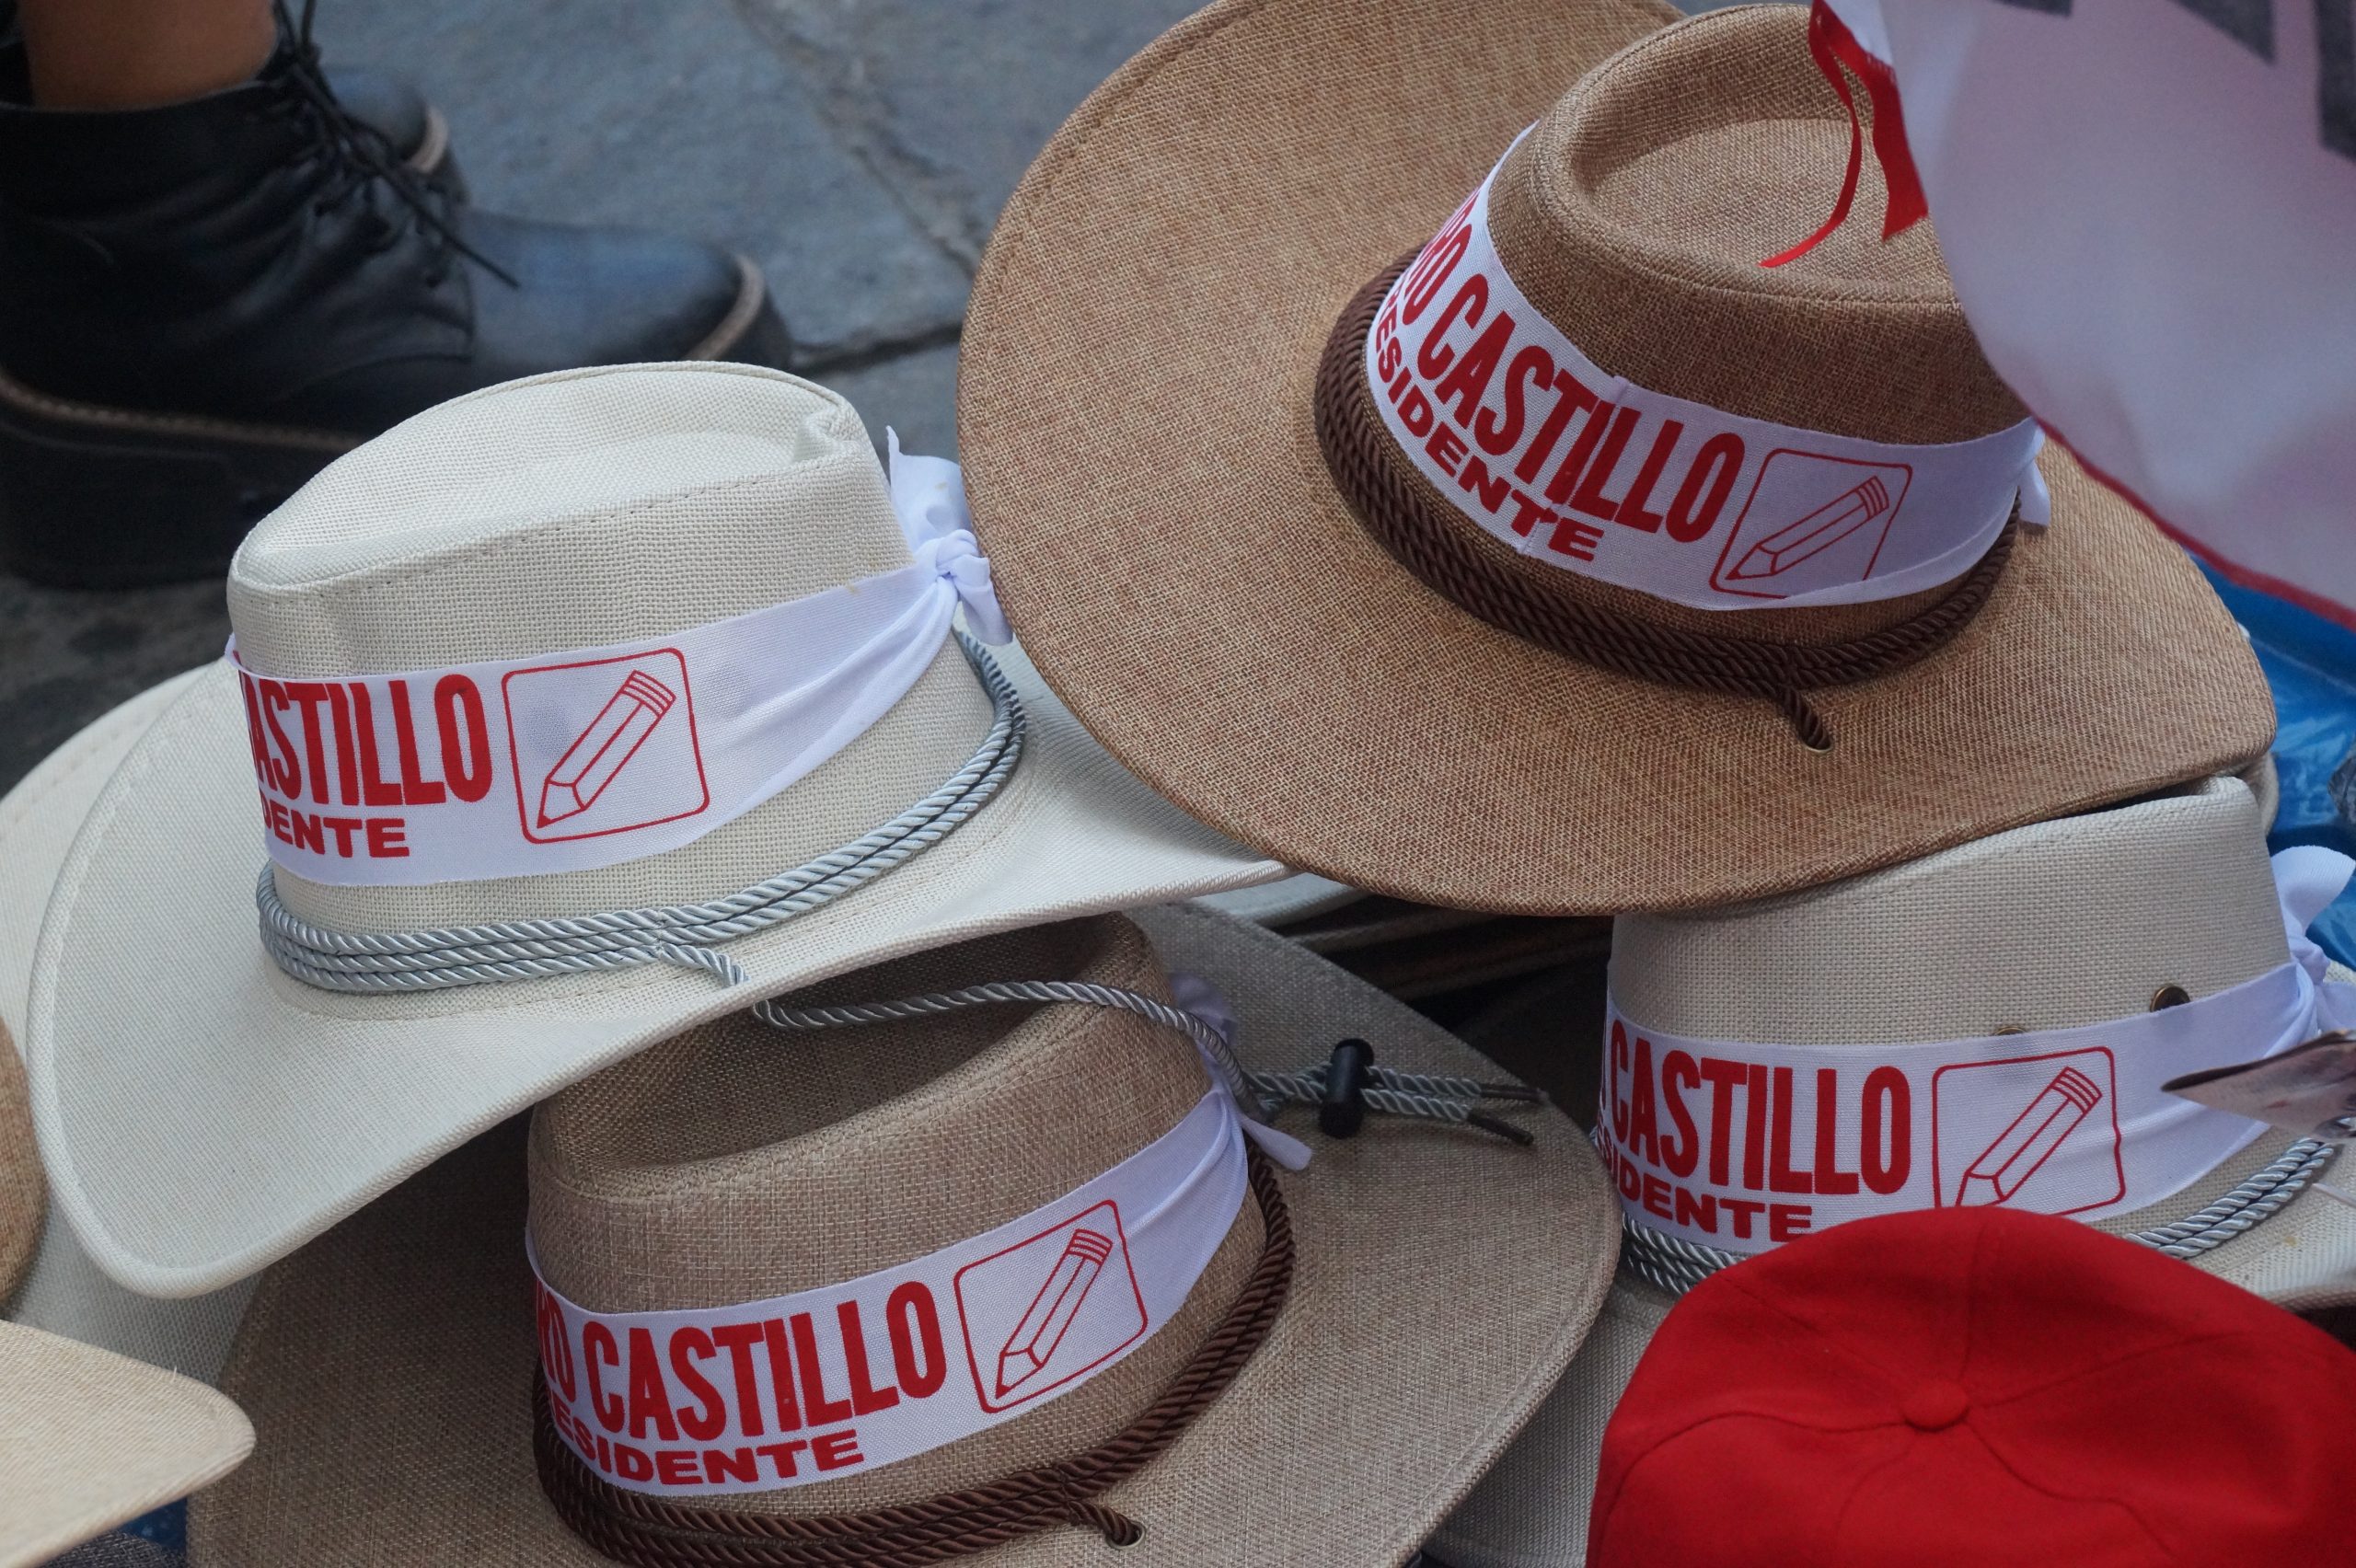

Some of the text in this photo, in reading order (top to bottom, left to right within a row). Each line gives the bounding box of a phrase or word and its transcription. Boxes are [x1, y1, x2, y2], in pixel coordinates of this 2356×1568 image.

[1418, 274, 1746, 543] CASTILLO
[238, 670, 493, 806] ASTILLO
[1612, 1020, 1911, 1195] CASTILLO
[546, 1385, 865, 1484] ESIDENTE
[583, 1282, 947, 1442] CASTILLO
